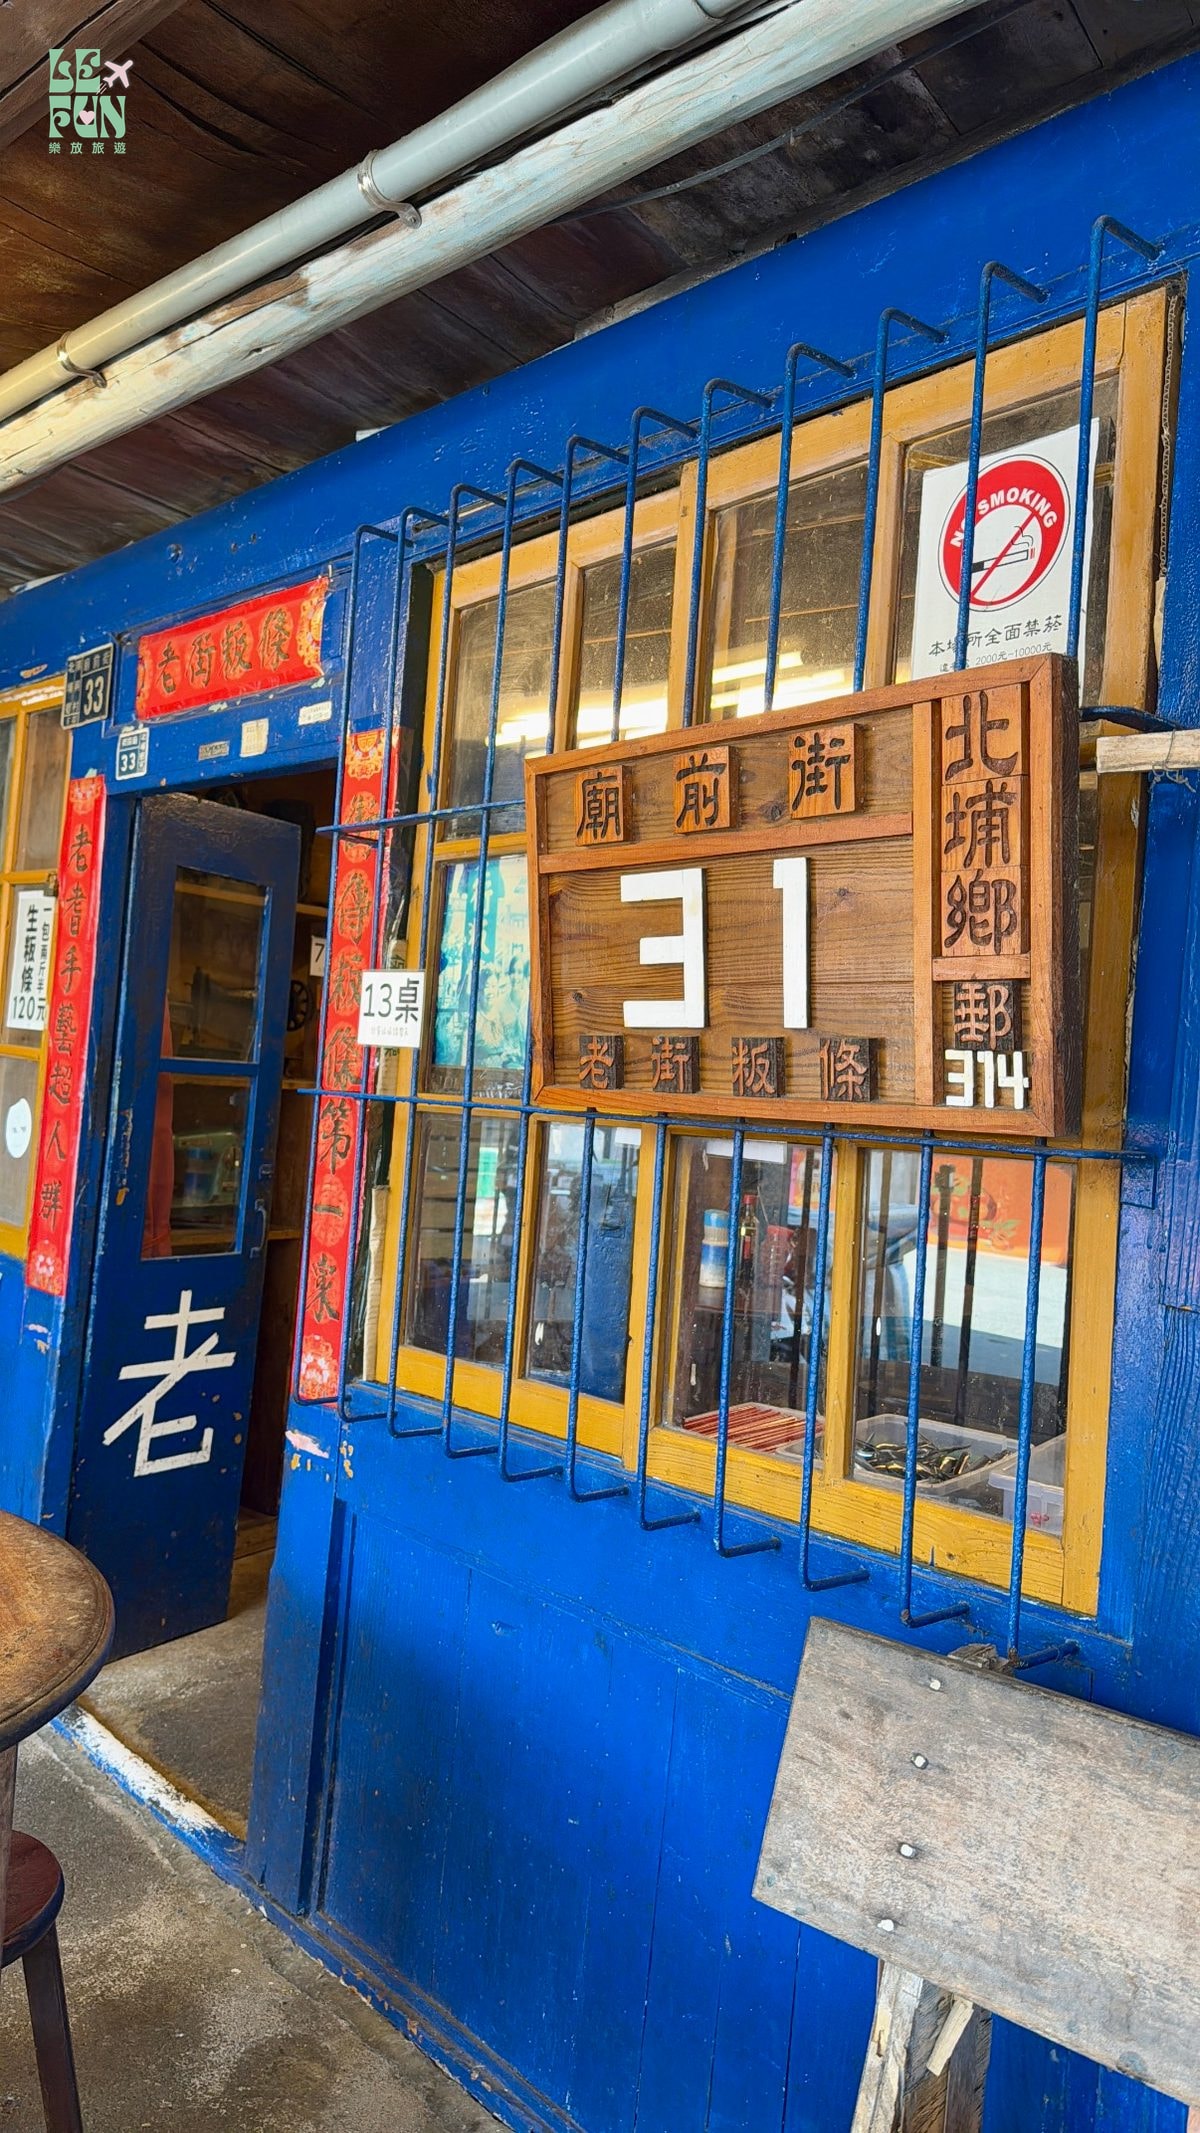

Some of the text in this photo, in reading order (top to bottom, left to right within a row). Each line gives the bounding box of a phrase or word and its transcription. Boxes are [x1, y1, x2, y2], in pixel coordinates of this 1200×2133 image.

[977, 487, 1058, 528] SMOKING
[83, 675, 104, 715] 33
[121, 752, 136, 772] 33
[576, 732, 852, 840] 廟前街
[943, 689, 1019, 955] 北埔鄉
[619, 857, 808, 1029] 31
[13, 996, 47, 1020] 120元
[363, 977, 420, 1023] 13桌
[953, 982, 1012, 1051] 郵
[944, 1049, 1030, 1110] 314
[102, 1289, 237, 1478] 老
